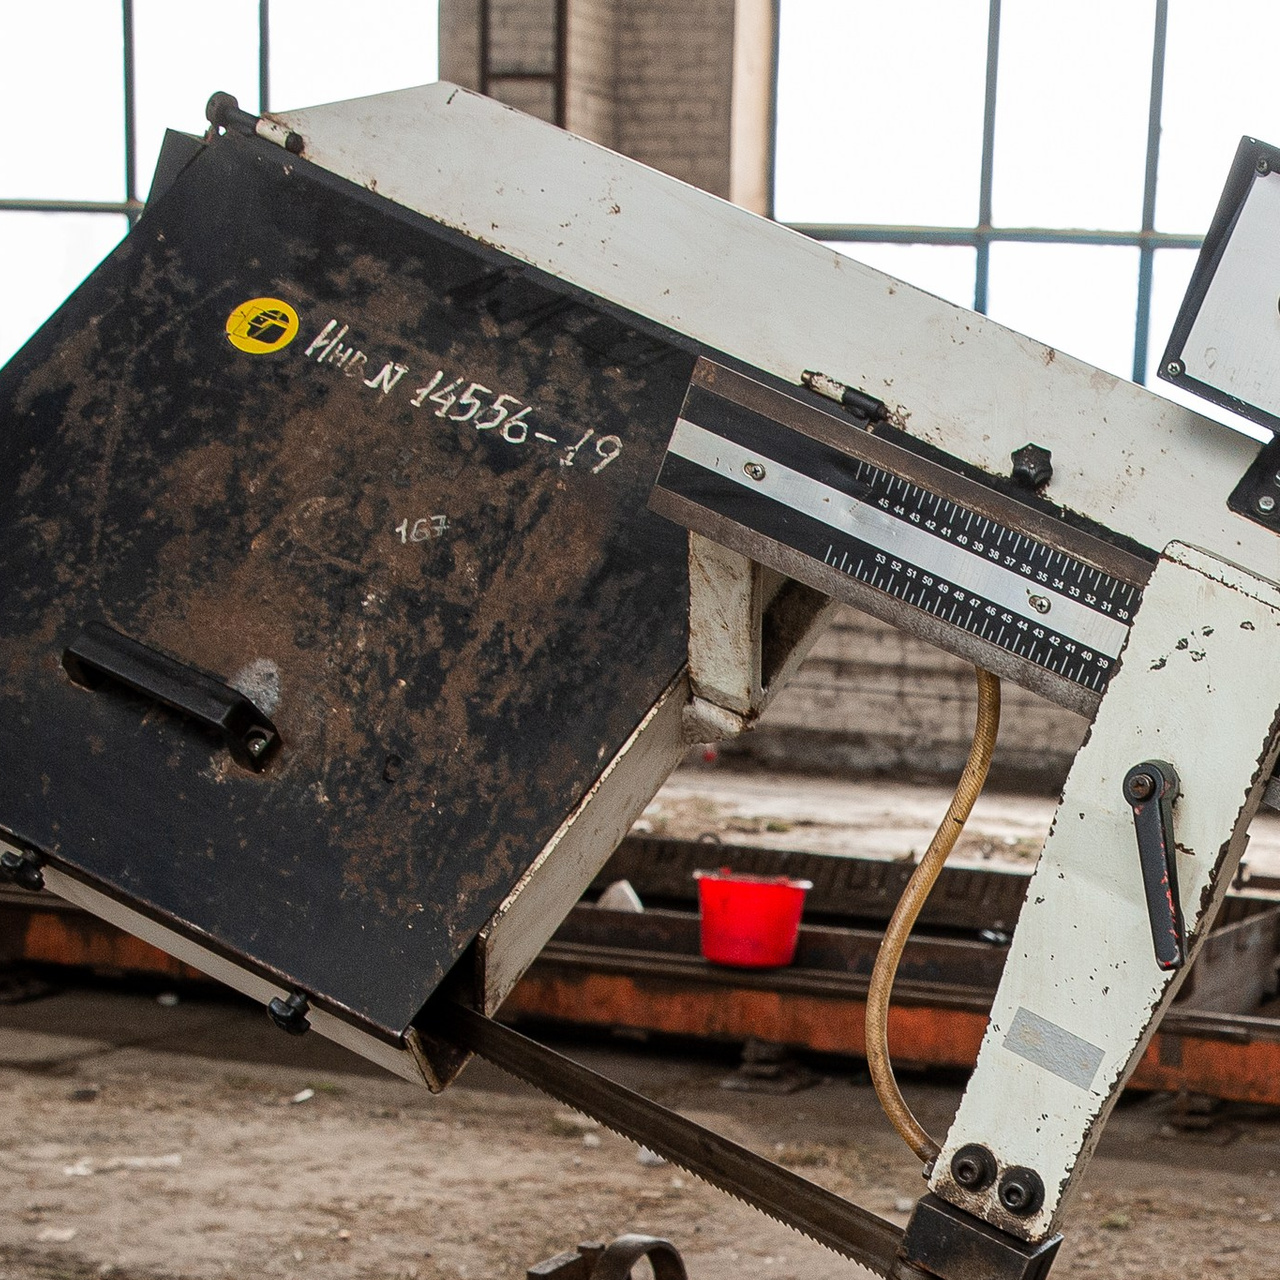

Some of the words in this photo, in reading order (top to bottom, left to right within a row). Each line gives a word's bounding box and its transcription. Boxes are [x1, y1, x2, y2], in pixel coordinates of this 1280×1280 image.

[409, 370, 623, 474] 14556-19
[875, 553, 886, 564] 53
[891, 560, 902, 572] 52
[906, 568, 917, 578] 51
[922, 575, 933, 586] 50
[938, 583, 949, 593] 49
[953, 591, 965, 601] 48
[969, 598, 981, 608] 47
[985, 606, 997, 616] 46
[1001, 613, 1013, 623] 45
[1017, 621, 1028, 631] 44
[1033, 628, 1044, 638] 43
[1049, 636, 1060, 646] 42
[1065, 643, 1076, 653] 41
[1081, 651, 1092, 661] 40
[1097, 657, 1108, 669] 39
[878, 498, 889, 508] 45
[894, 505, 904, 515] 44
[909, 512, 920, 523] 43
[925, 520, 936, 530] 42
[941, 527, 951, 537] 41
[956, 534, 968, 545] 40
[972, 541, 984, 552] 39
[988, 548, 1000, 560] 38
[1004, 556, 1016, 566] 37
[1020, 563, 1032, 574] 36
[1036, 571, 1048, 582] 35
[1052, 578, 1064, 589] 34
[1068, 586, 1080, 597] 33
[1085, 593, 1096, 605] 32
[1101, 601, 1112, 612] 31
[1117, 609, 1129, 620] 30
